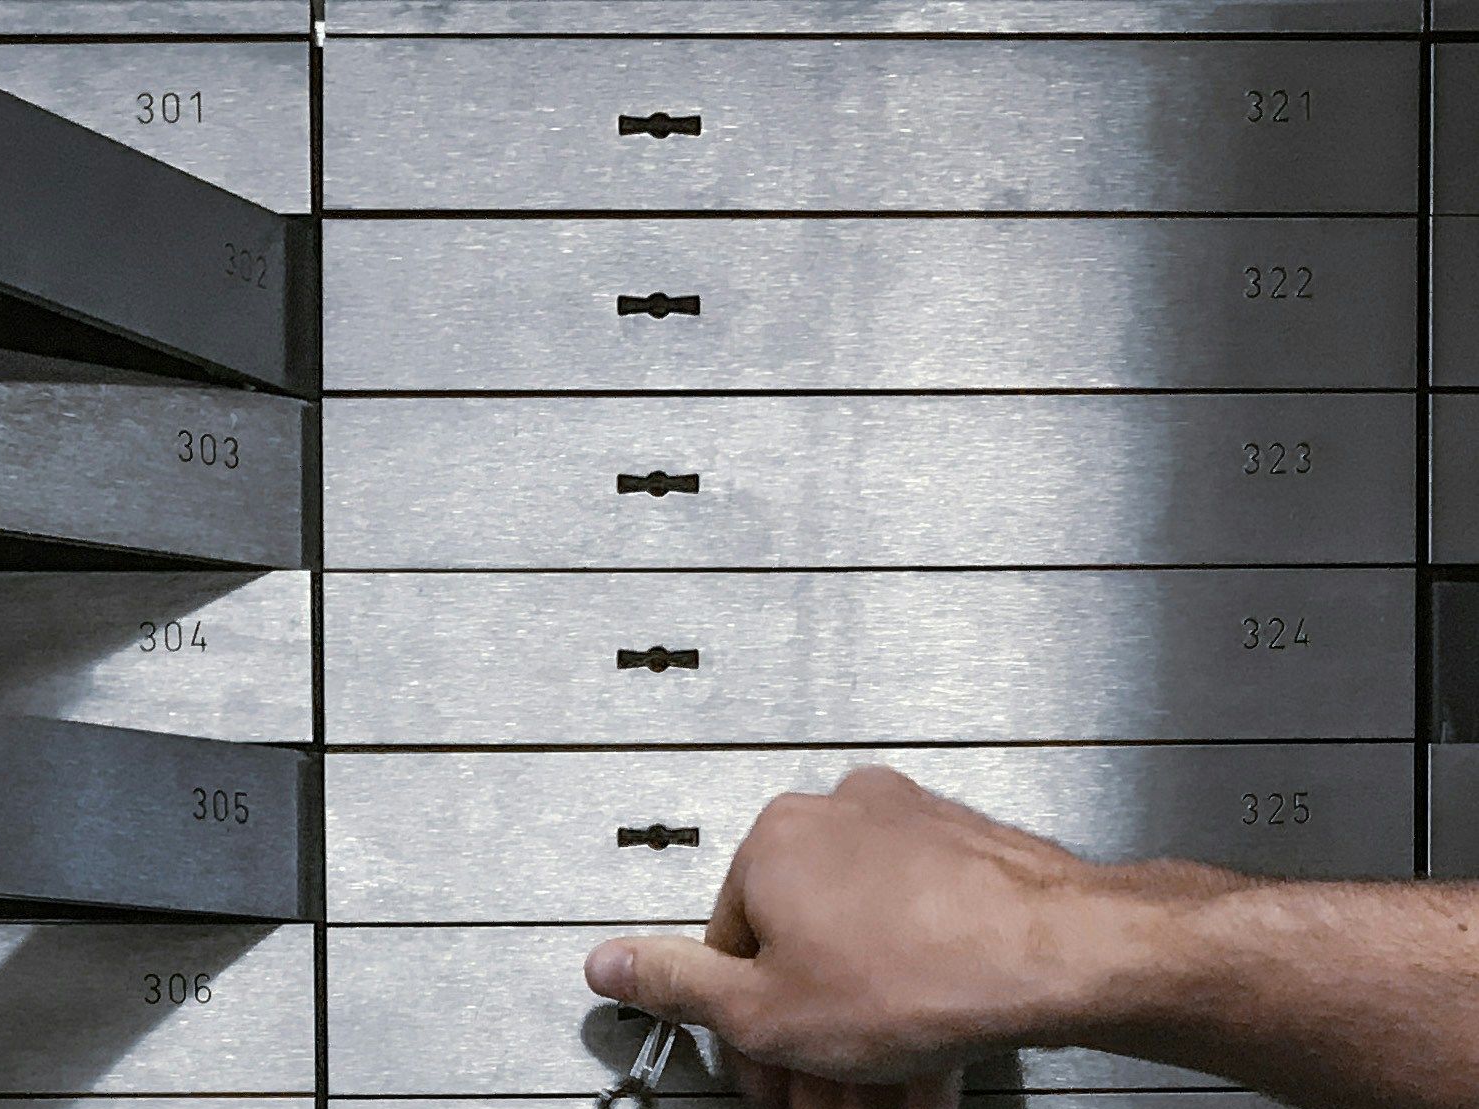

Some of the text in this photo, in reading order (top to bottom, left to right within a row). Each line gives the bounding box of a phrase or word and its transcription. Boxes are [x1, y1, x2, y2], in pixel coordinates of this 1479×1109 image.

[136, 90, 202, 125] 301
[1245, 89, 1311, 124] 321
[224, 242, 267, 290] 302
[1244, 266, 1314, 300] 322
[177, 429, 240, 470] 303
[1242, 442, 1312, 476] 323
[139, 620, 207, 653] 304
[1242, 617, 1311, 651] 324
[192, 787, 249, 825] 305
[1240, 791, 1311, 825] 325
[143, 972, 212, 1005] 306
